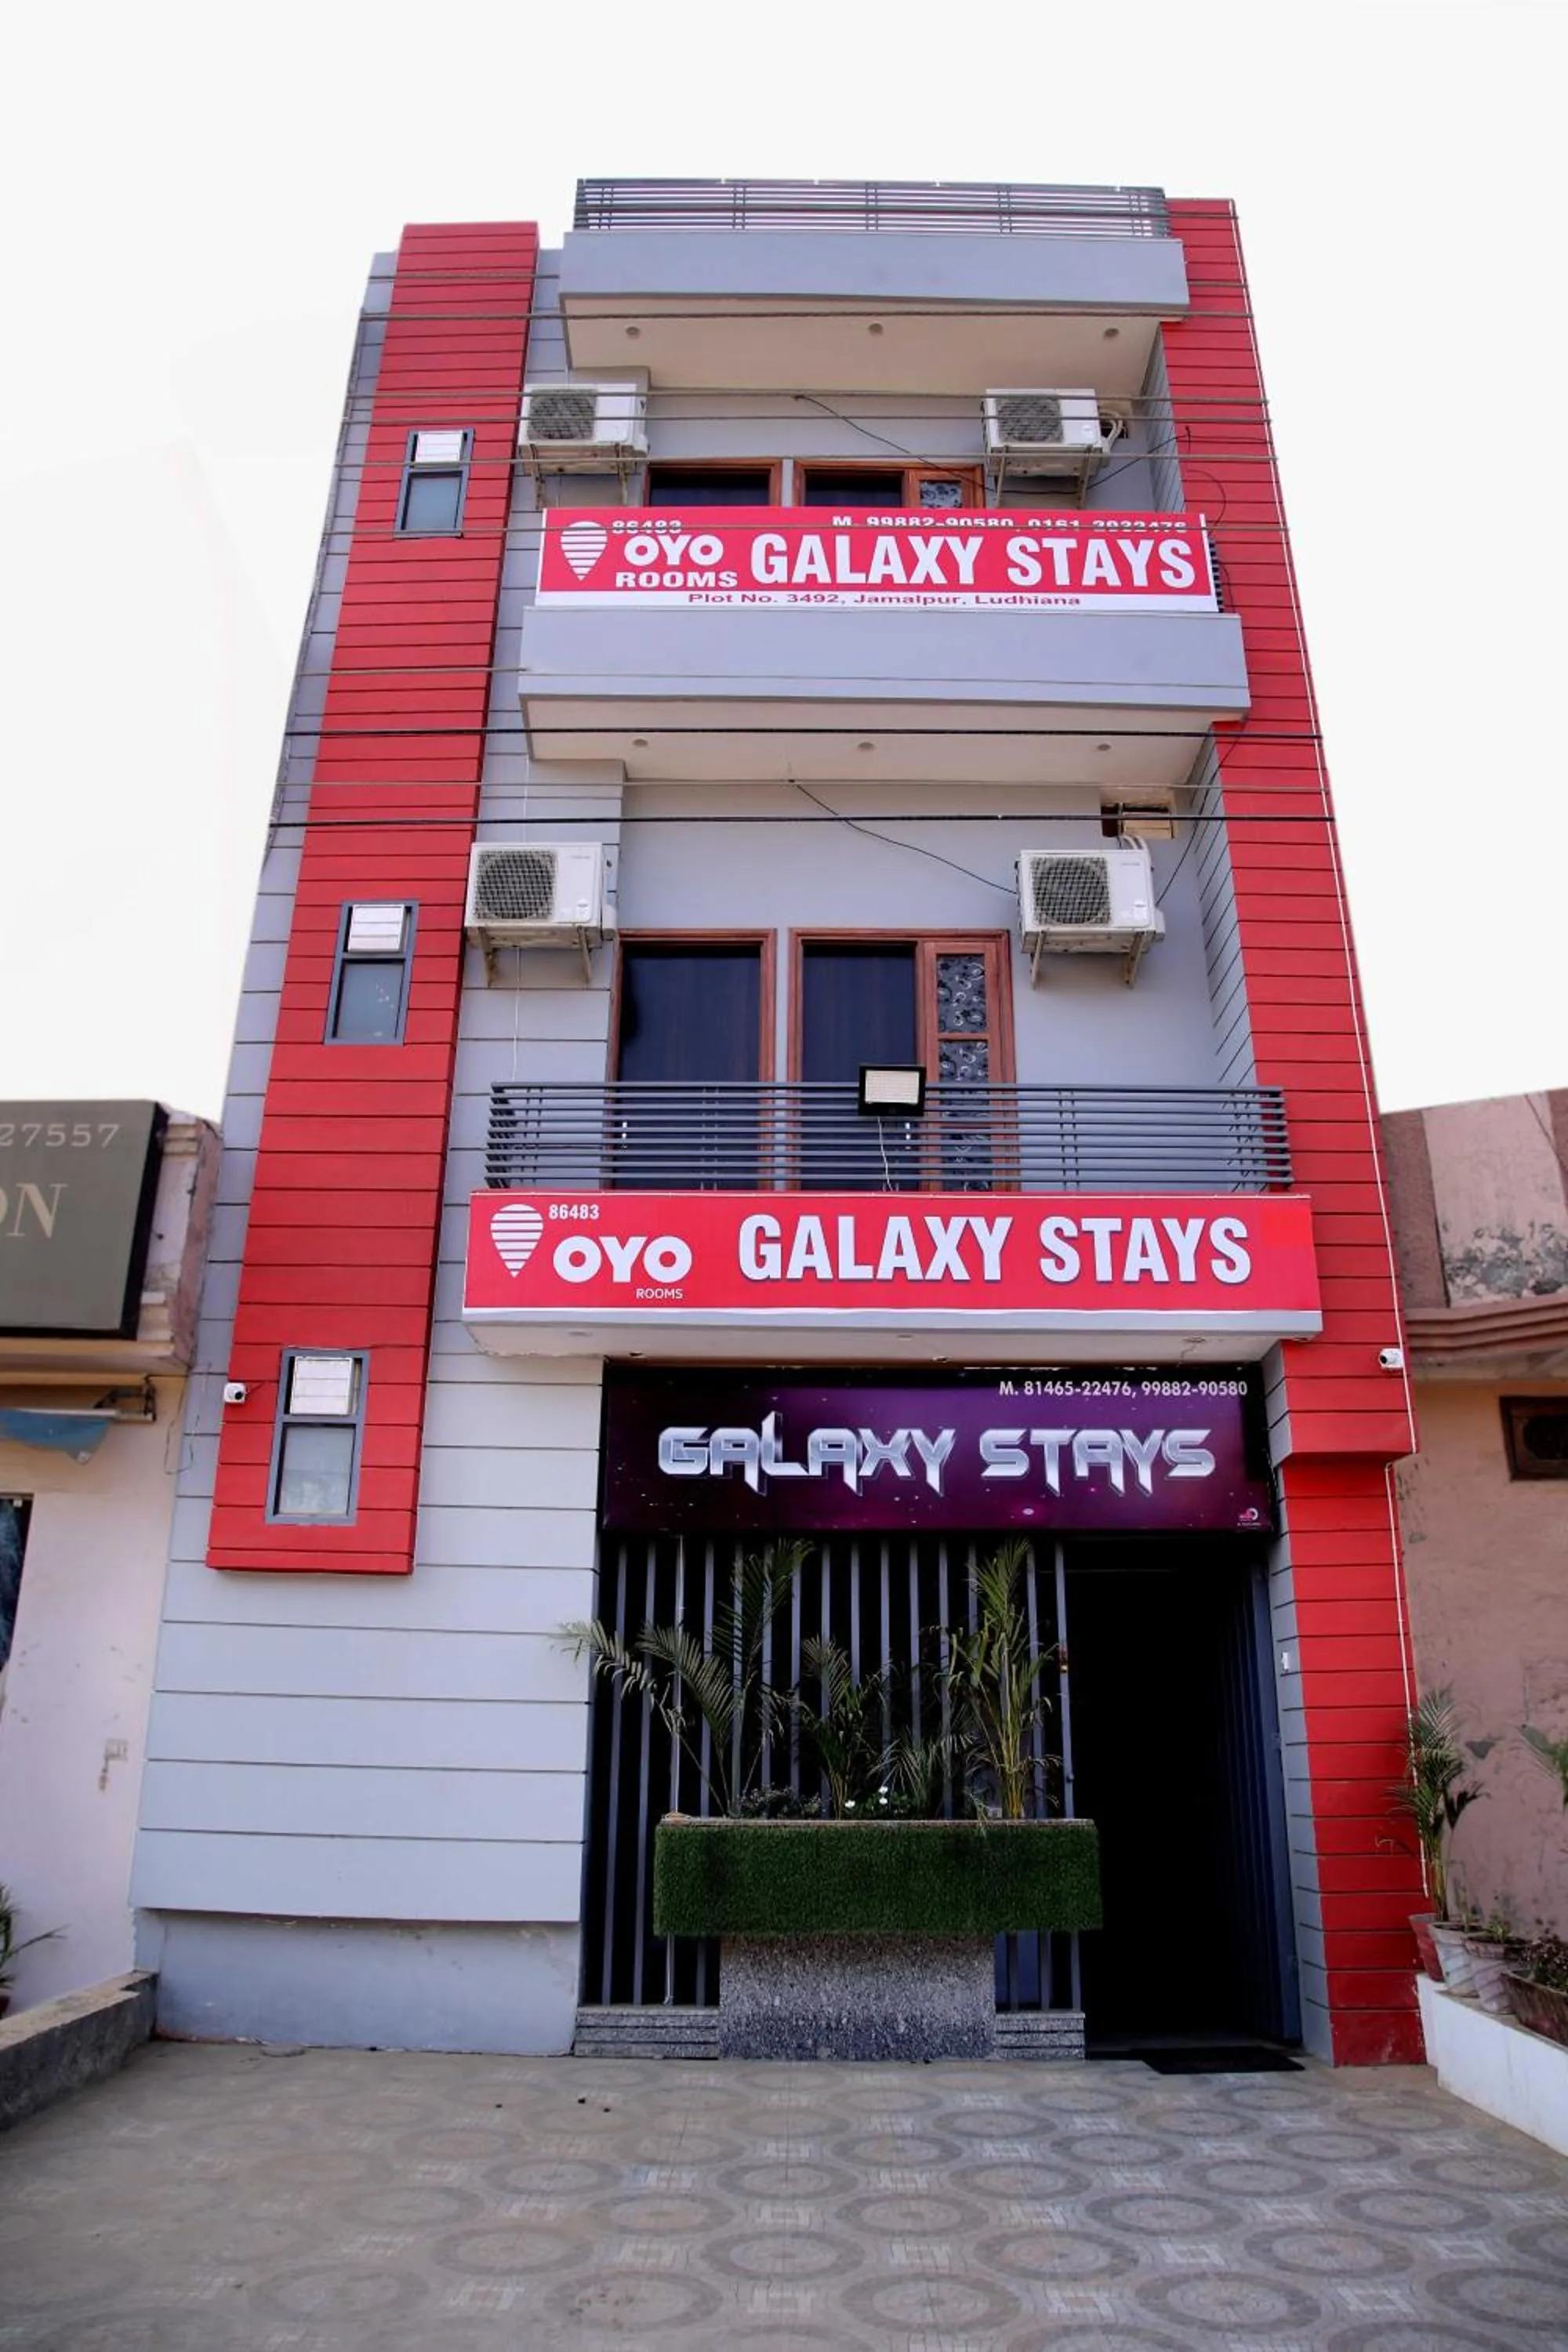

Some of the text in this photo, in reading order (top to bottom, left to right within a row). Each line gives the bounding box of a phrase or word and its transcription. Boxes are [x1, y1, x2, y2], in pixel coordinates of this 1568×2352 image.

[623, 533, 1196, 589] OYO GALAXY STAYS
[615, 571, 738, 588] ROOMS
[688, 593, 1082, 606] Plot No. 3492, Jamalpur, Ludhiana
[0, 1123, 120, 1148] 27557
[548, 1203, 601, 1220] 86483
[553, 1214, 1252, 1286] OYO GALAXY STAYS
[636, 1288, 684, 1300] ROOMS
[999, 1381, 1248, 1399] M. 81465-22476, 99882-90580
[658, 1410, 1216, 1497] GALAXY STAYS
